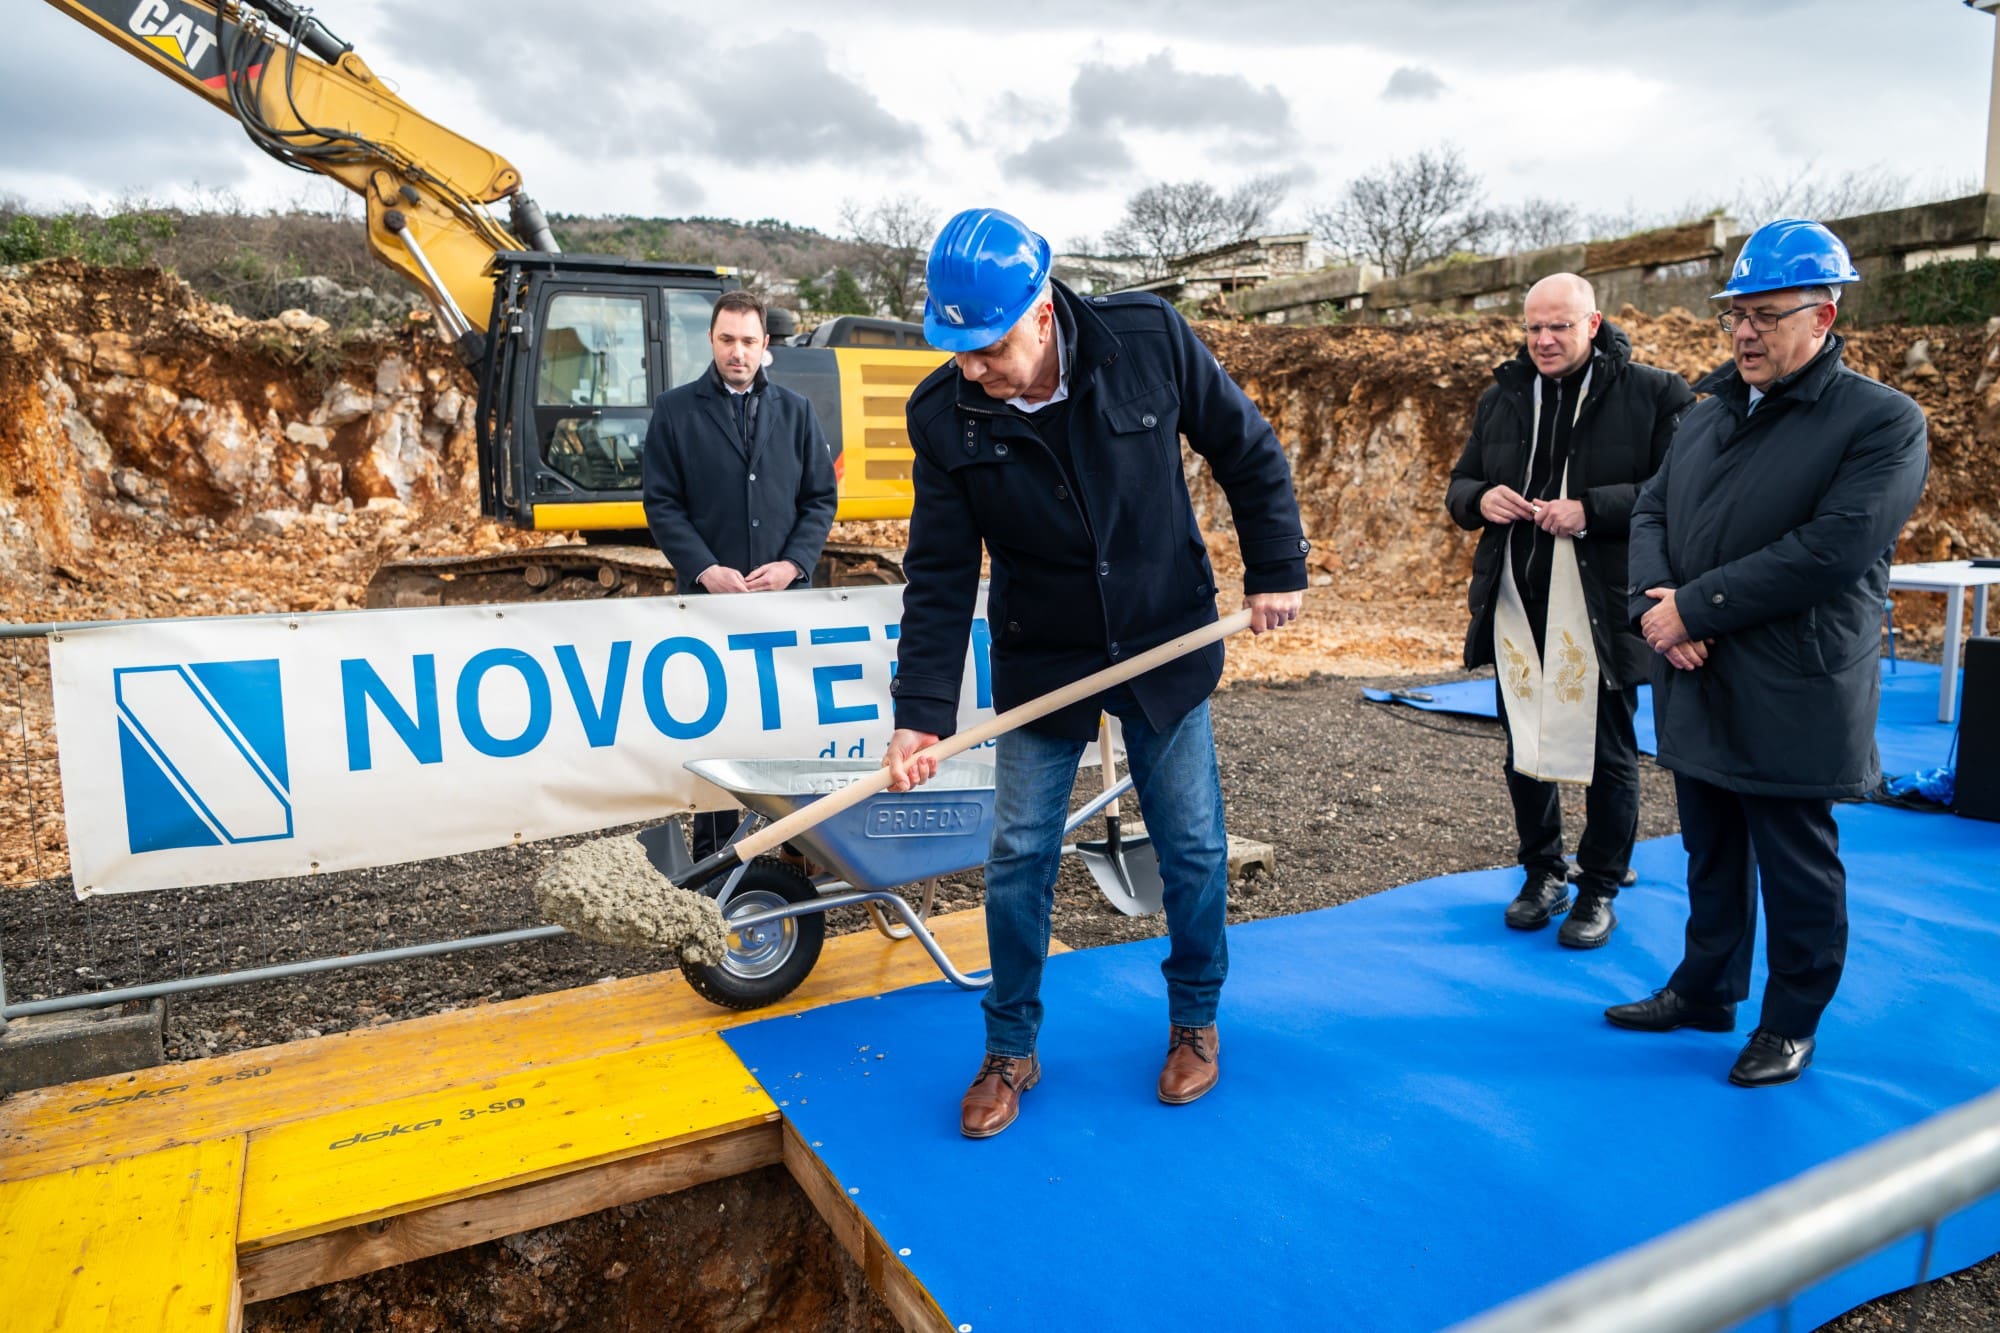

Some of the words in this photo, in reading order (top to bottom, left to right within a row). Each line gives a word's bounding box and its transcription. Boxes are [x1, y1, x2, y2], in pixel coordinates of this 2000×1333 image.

[128, 0, 218, 70] CAT
[340, 617, 993, 772] NOVOTE
[69, 1084, 189, 1113] doka
[328, 1117, 443, 1151] doka
